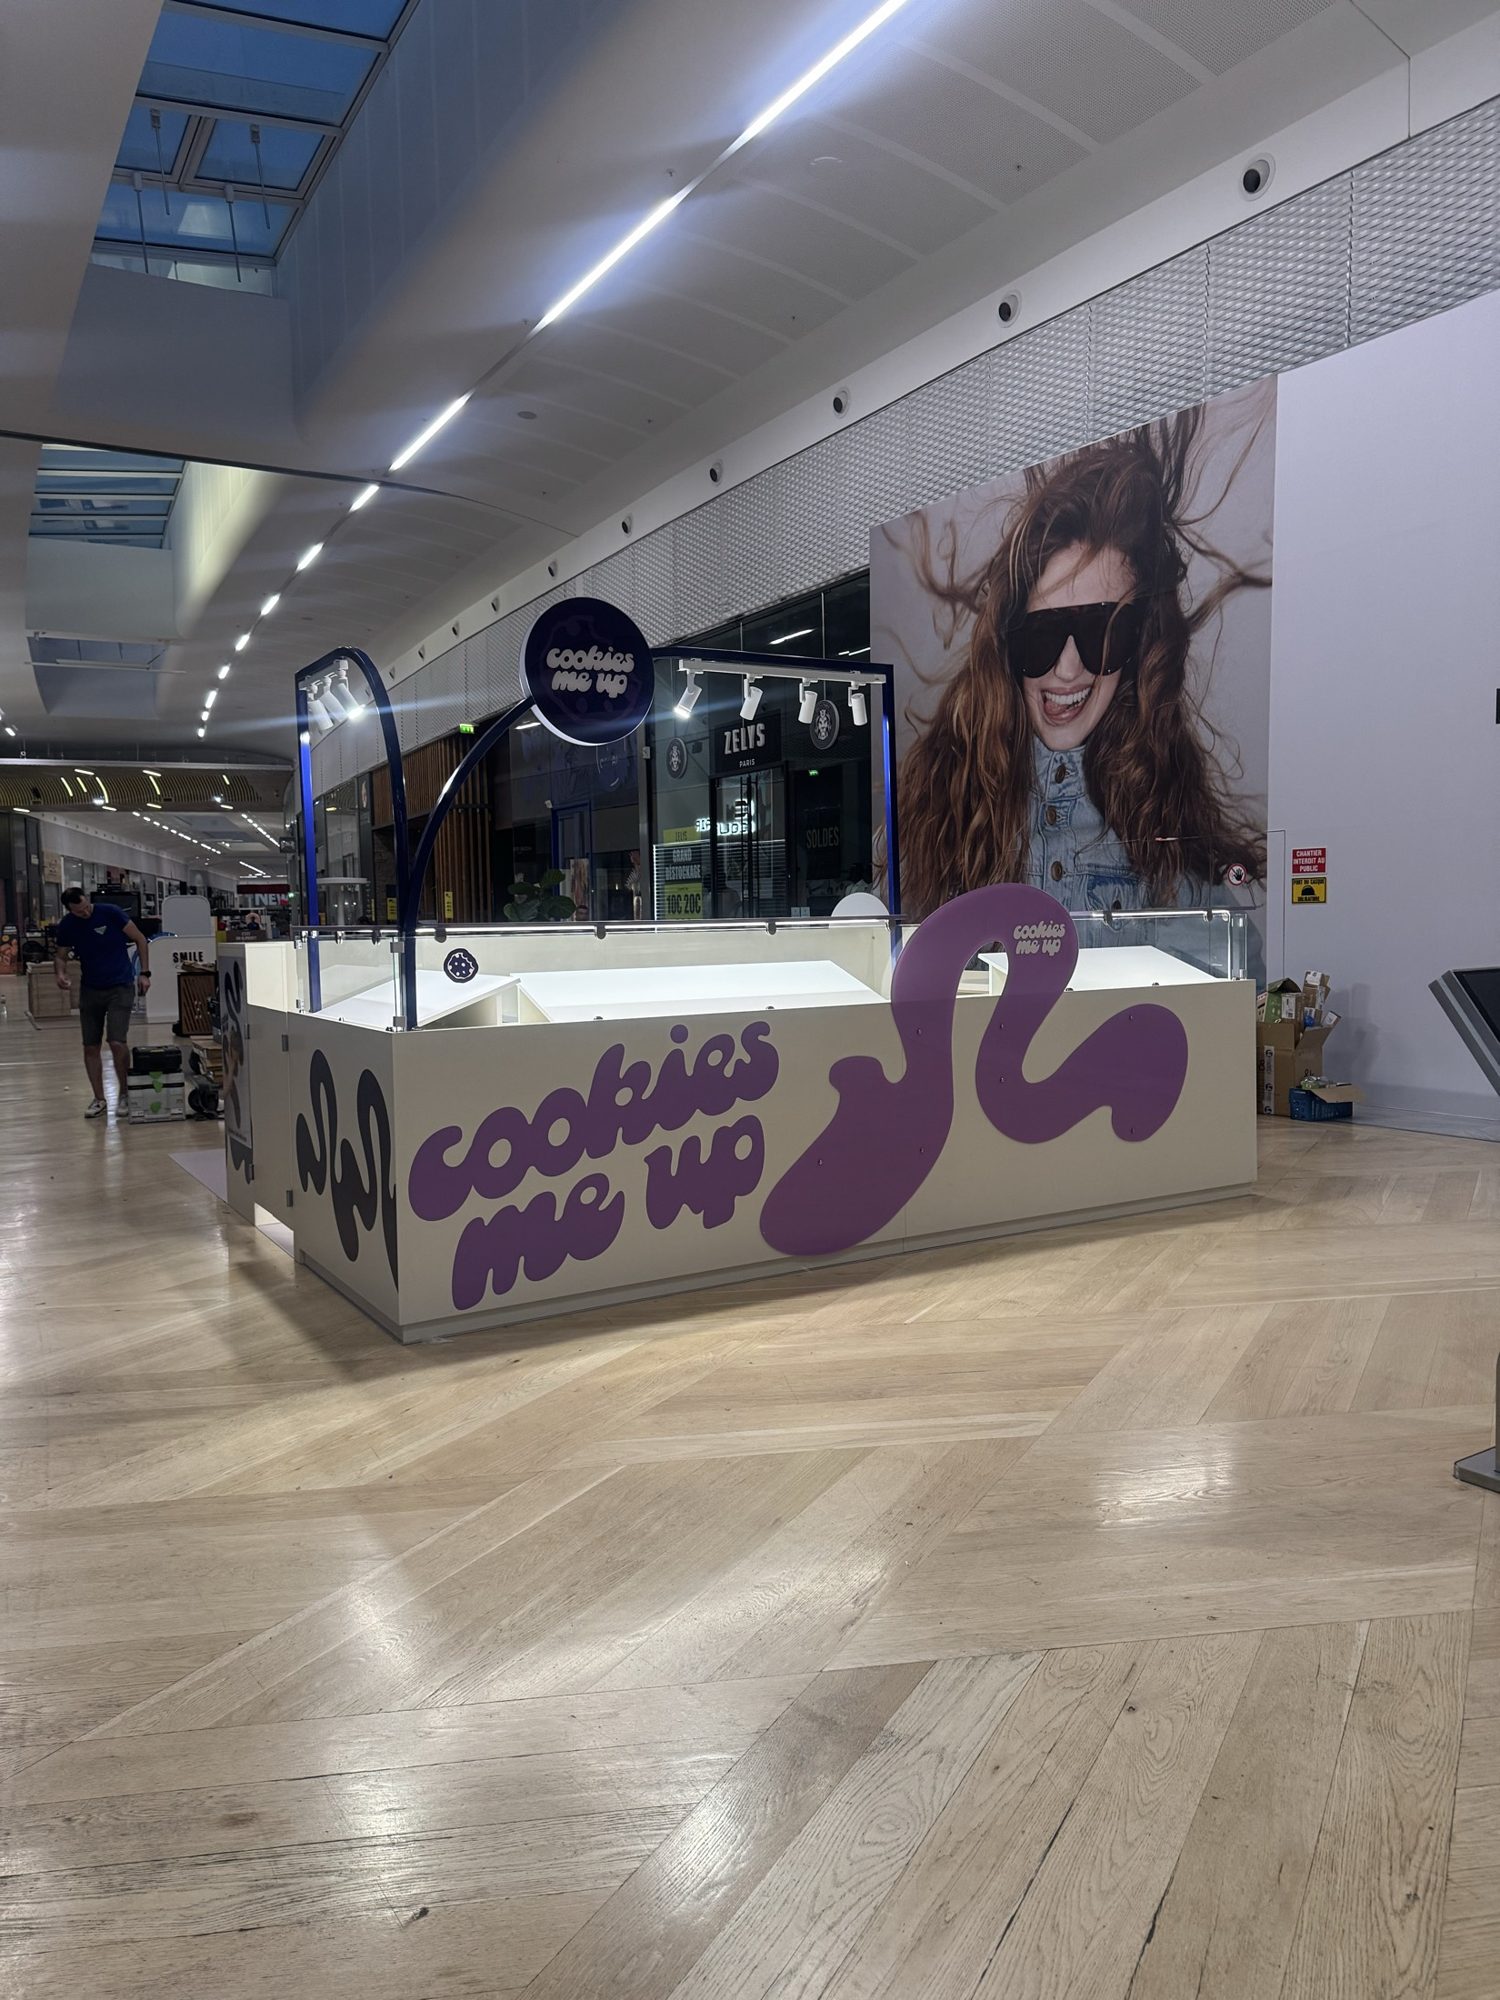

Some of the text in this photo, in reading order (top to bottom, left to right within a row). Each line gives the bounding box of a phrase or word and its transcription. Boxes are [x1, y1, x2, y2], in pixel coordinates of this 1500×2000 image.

[546, 645, 635, 673] cookies
[551, 671, 628, 698] me up
[724, 723, 765, 755] ZELYS
[739, 759, 756, 768] PARIS
[806, 826, 839, 849] SOLDES
[672, 848, 692, 862] GRAND
[1293, 857, 1317, 865] INTERDIT
[1296, 849, 1322, 857] CHANTIER
[1013, 920, 1066, 940] cookies
[172, 951, 204, 963] SMILE
[1015, 938, 1061, 956] me up
[408, 1021, 780, 1222] cookies
[451, 1114, 766, 1311] me up
